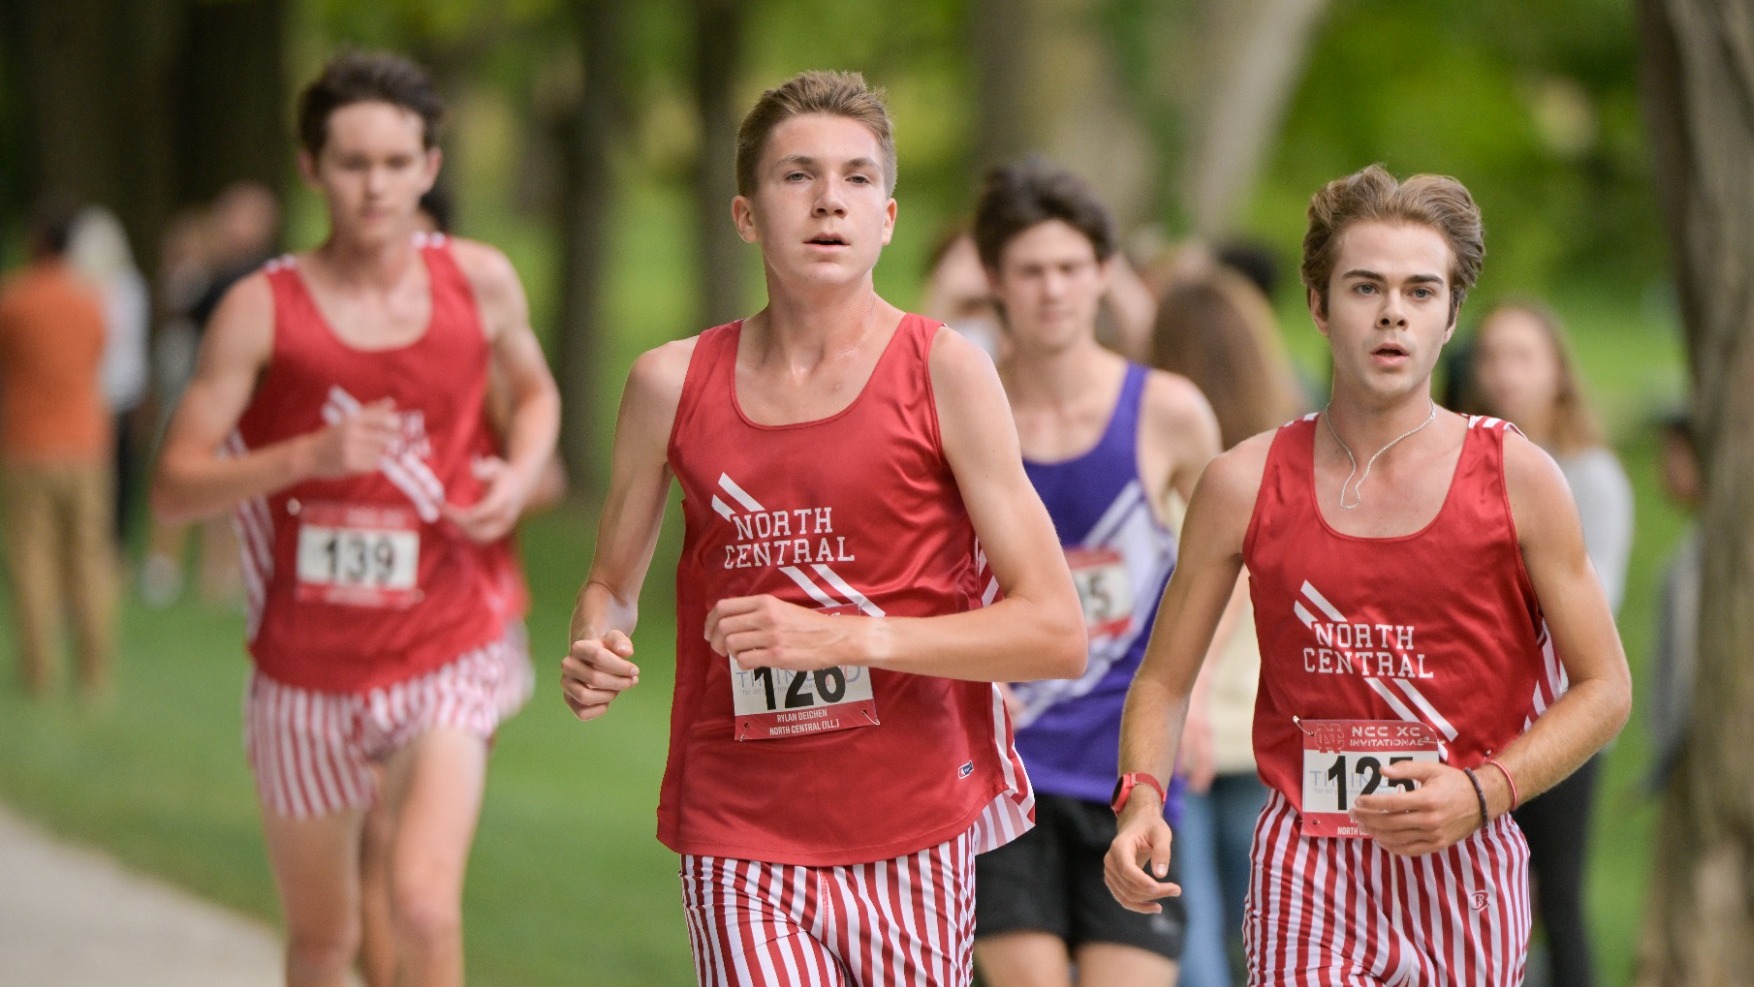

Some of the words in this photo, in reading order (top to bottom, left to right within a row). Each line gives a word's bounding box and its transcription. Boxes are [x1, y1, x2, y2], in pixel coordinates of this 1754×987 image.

[732, 507, 833, 541] NORTH
[325, 534, 395, 584] 139
[724, 536, 855, 569] CENTRAL
[1314, 623, 1415, 650] NORTH
[1303, 647, 1434, 678] CENTRAL
[754, 664, 846, 710] 126
[769, 725, 791, 736] NORTH
[791, 721, 821, 734] CENTRAL
[776, 712, 797, 723] RYLAN
[1349, 738, 1425, 747] INVITATIONAL
[1351, 726, 1389, 737] NCC
[1396, 726, 1421, 737] XC
[1337, 826, 1359, 836] NORTH
